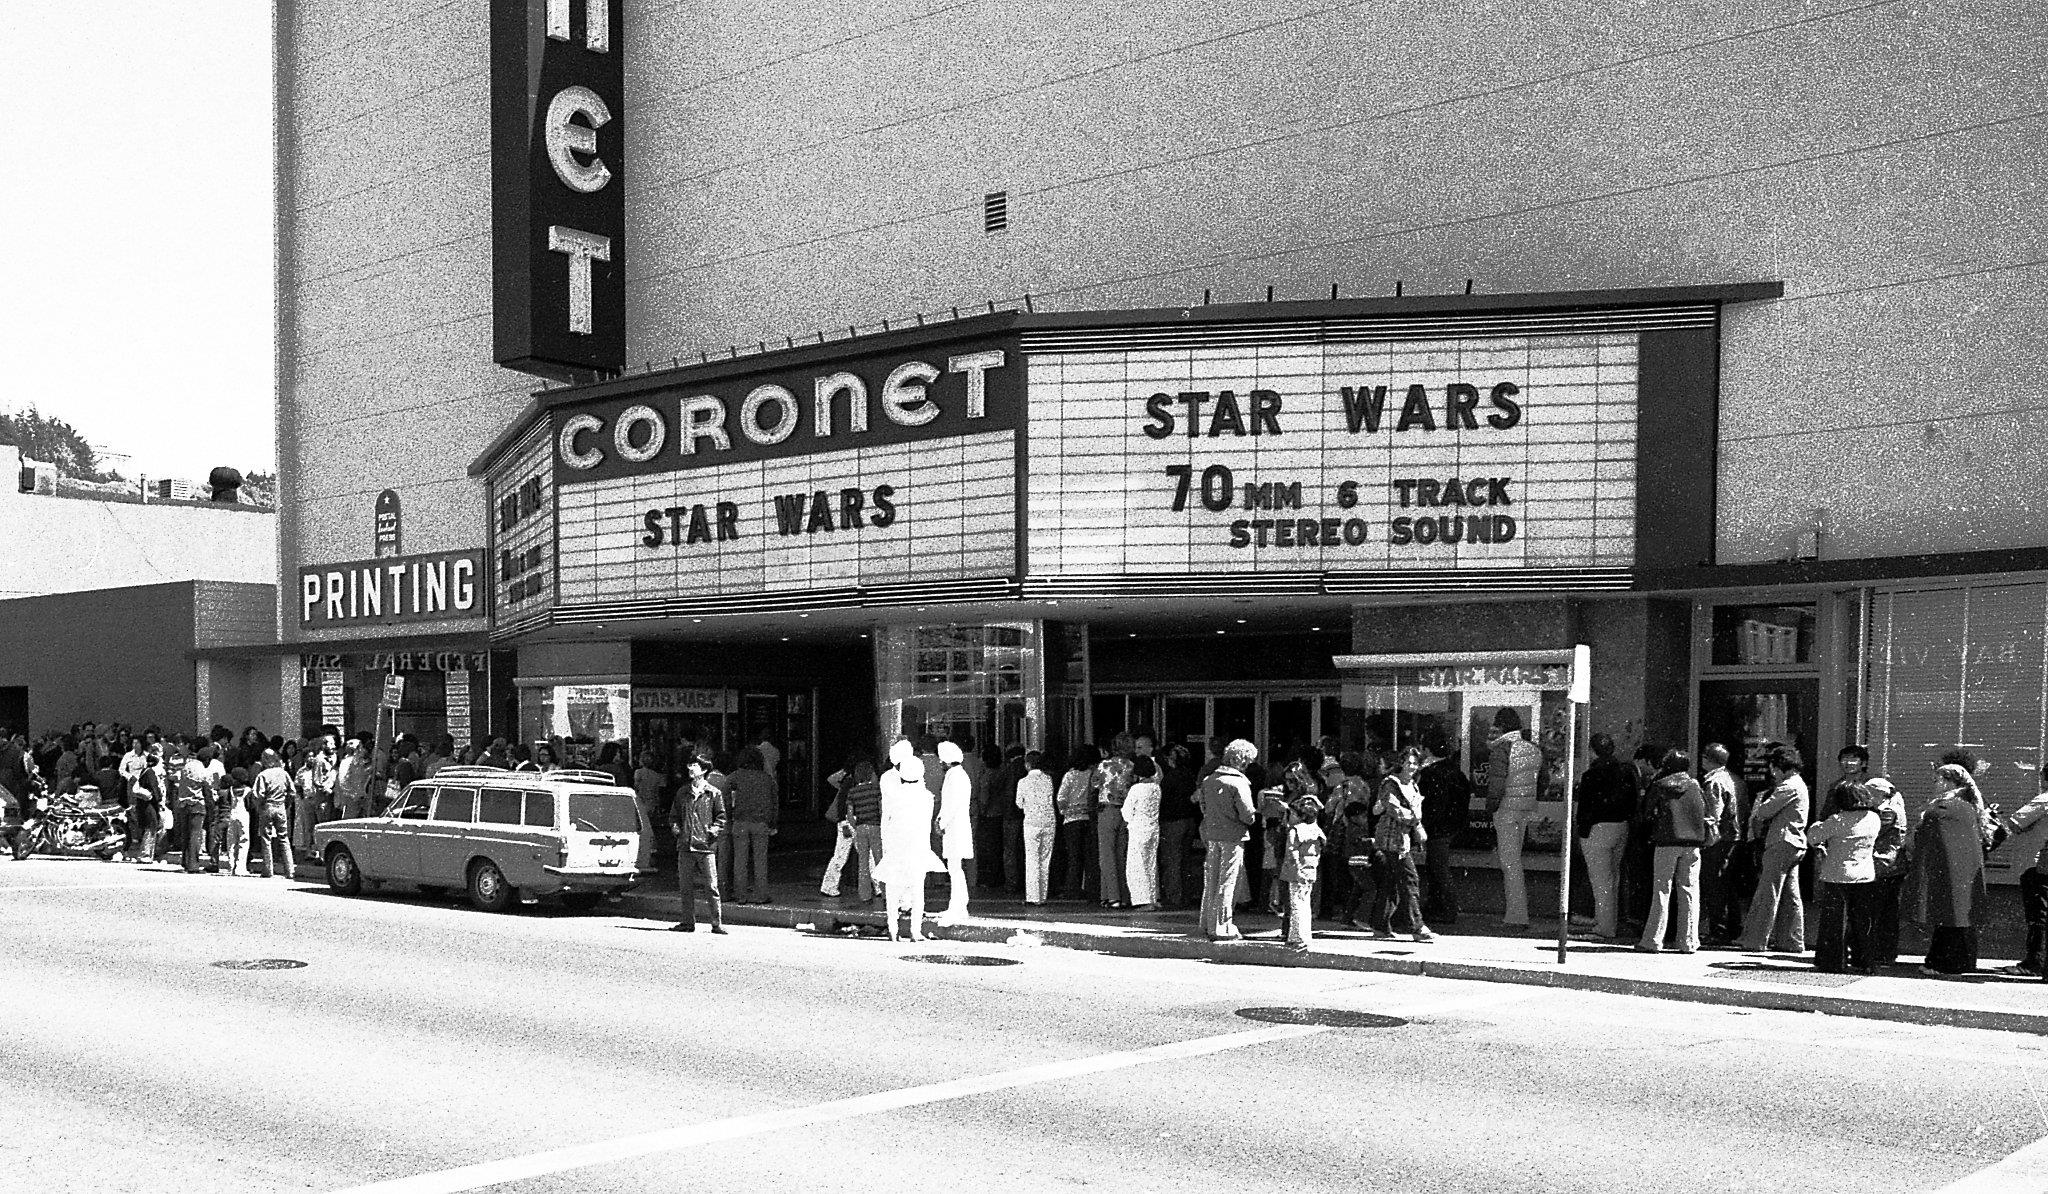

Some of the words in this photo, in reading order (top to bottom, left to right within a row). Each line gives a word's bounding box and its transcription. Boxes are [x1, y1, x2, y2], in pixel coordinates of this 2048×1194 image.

[559, 350, 1004, 470] CORONET
[1143, 389, 1283, 439] STAR
[1341, 382, 1522, 434] WARS
[642, 501, 740, 548] STAR
[774, 484, 896, 536] WARS
[1337, 481, 1359, 509] 6
[1393, 477, 1512, 508] TRACK
[1229, 517, 1368, 549] STEREO
[1391, 514, 1517, 545] SOUND
[303, 559, 473, 621] PRINTING
[632, 691, 675, 708] STAR
[677, 691, 718, 708] WARS
